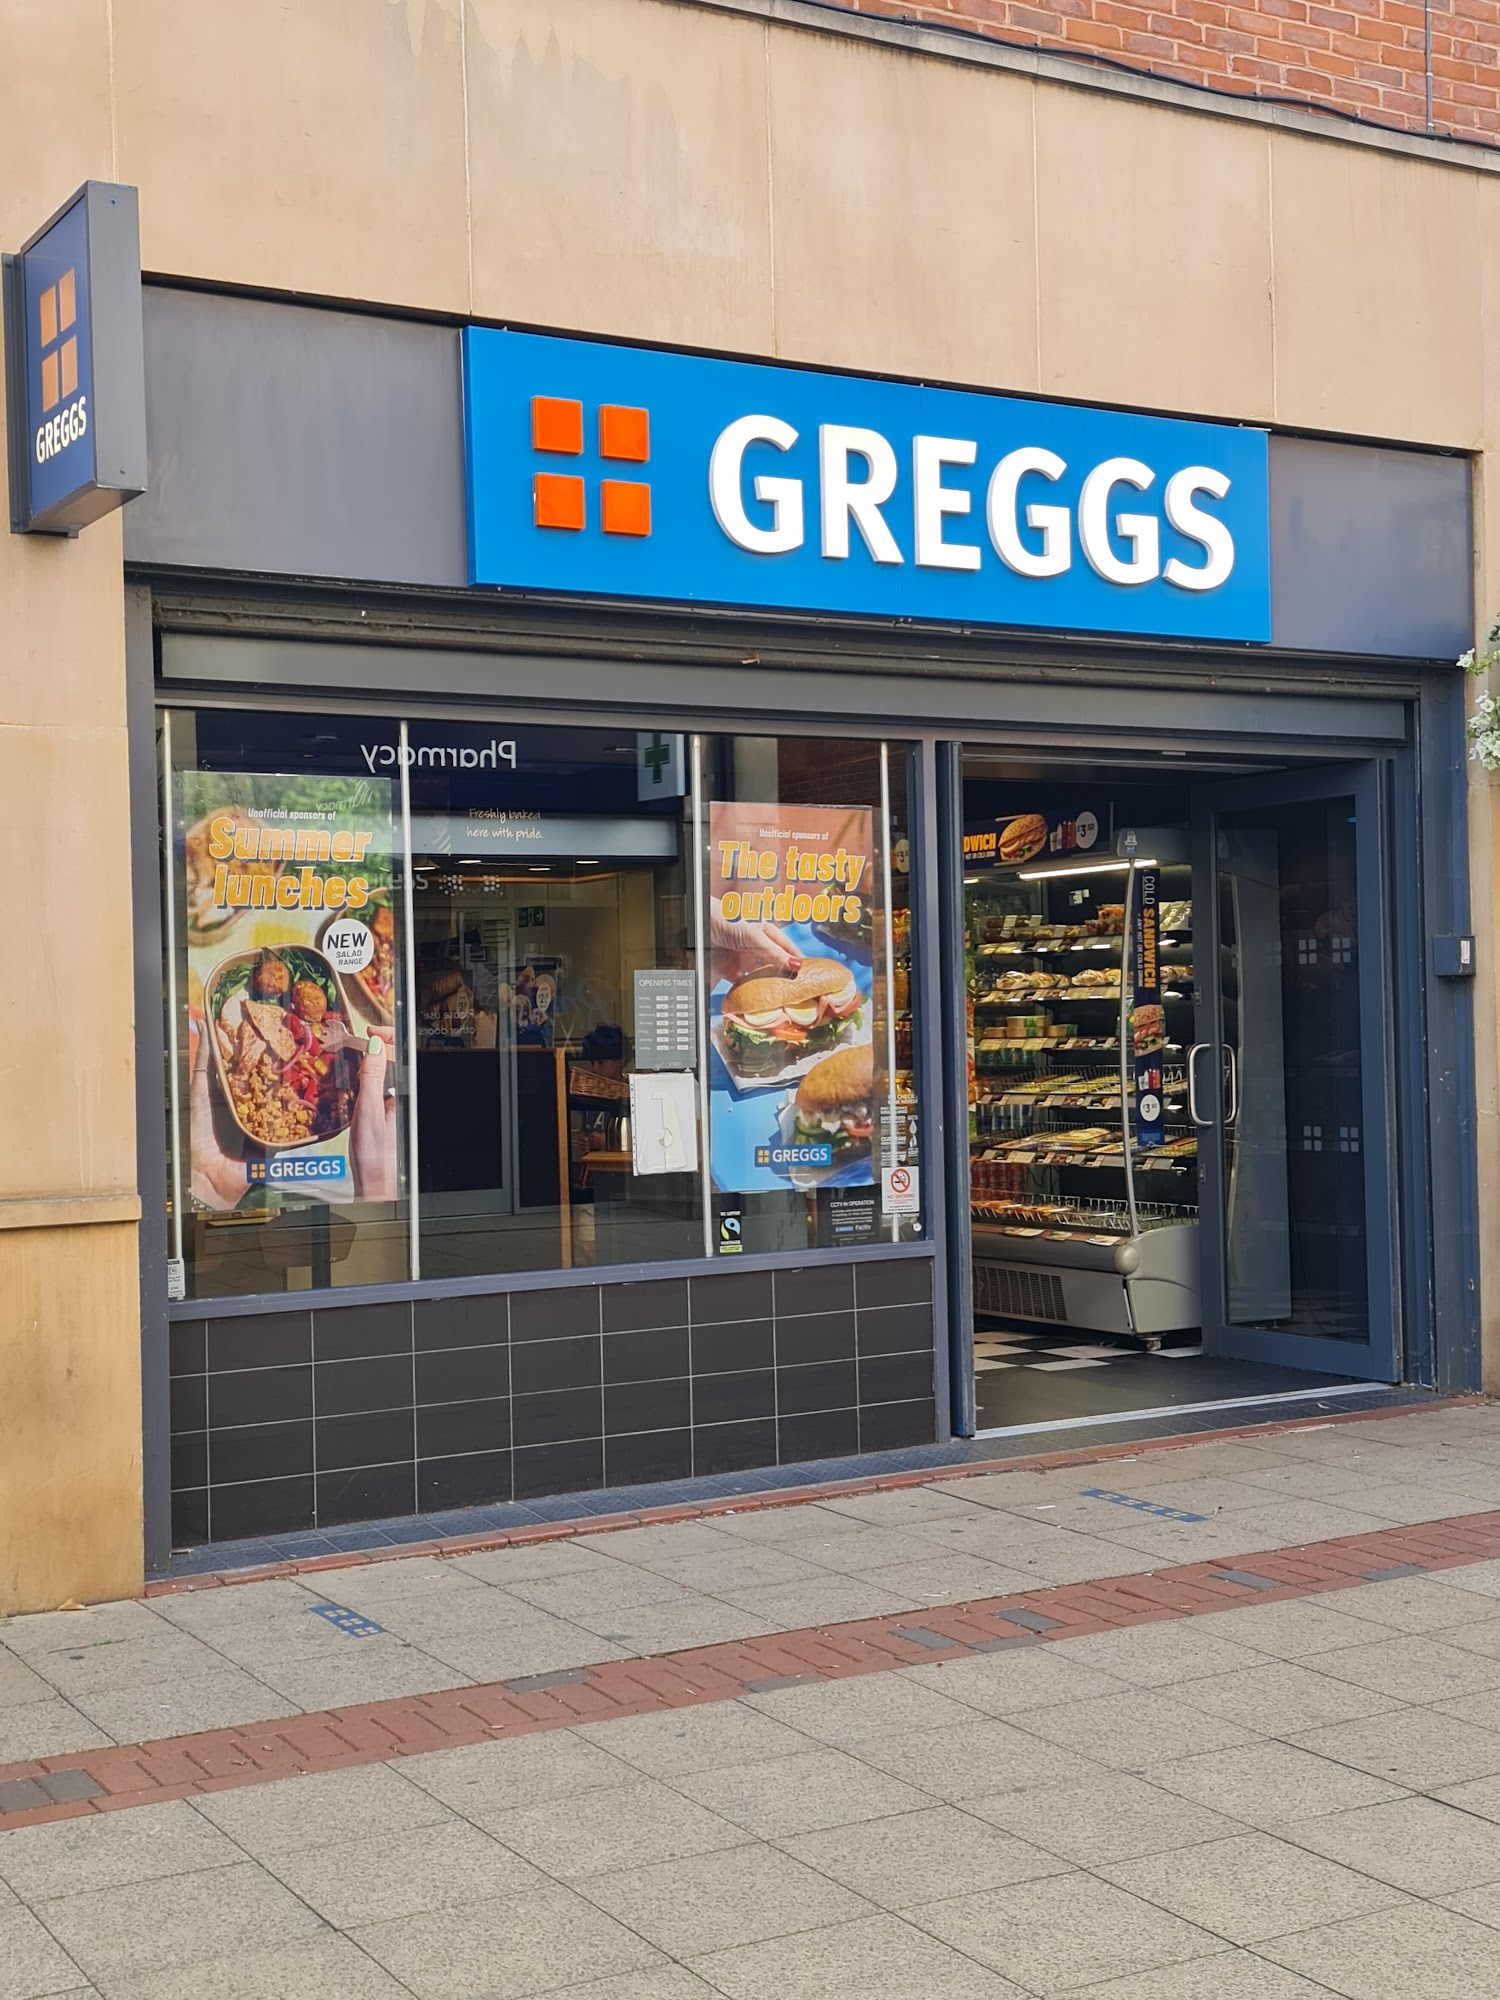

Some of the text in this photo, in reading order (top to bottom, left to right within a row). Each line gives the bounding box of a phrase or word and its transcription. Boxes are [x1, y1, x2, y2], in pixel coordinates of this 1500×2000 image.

[35, 395, 87, 464] GREGGS
[709, 413, 1236, 591] GREGGS
[248, 808, 336, 821] Unofficial sponsors of
[468, 808, 541, 824] Freshly baked
[208, 816, 373, 863] Summer
[466, 826, 490, 838] here
[491, 826, 515, 838] with
[759, 828, 830, 841] Unofficial sponsors of
[718, 840, 867, 893] The tasty
[213, 864, 370, 909] lunches
[720, 885, 862, 924] outdoors
[1143, 875, 1157, 988] COLD SANDWICH
[326, 932, 369, 950] NEW
[335, 949, 363, 959] SALAD
[338, 957, 364, 966] RANGE
[638, 979, 693, 987] OPENING TIMES
[772, 1147, 828, 1163] GREGGS
[269, 1160, 341, 1178] GREGGS
